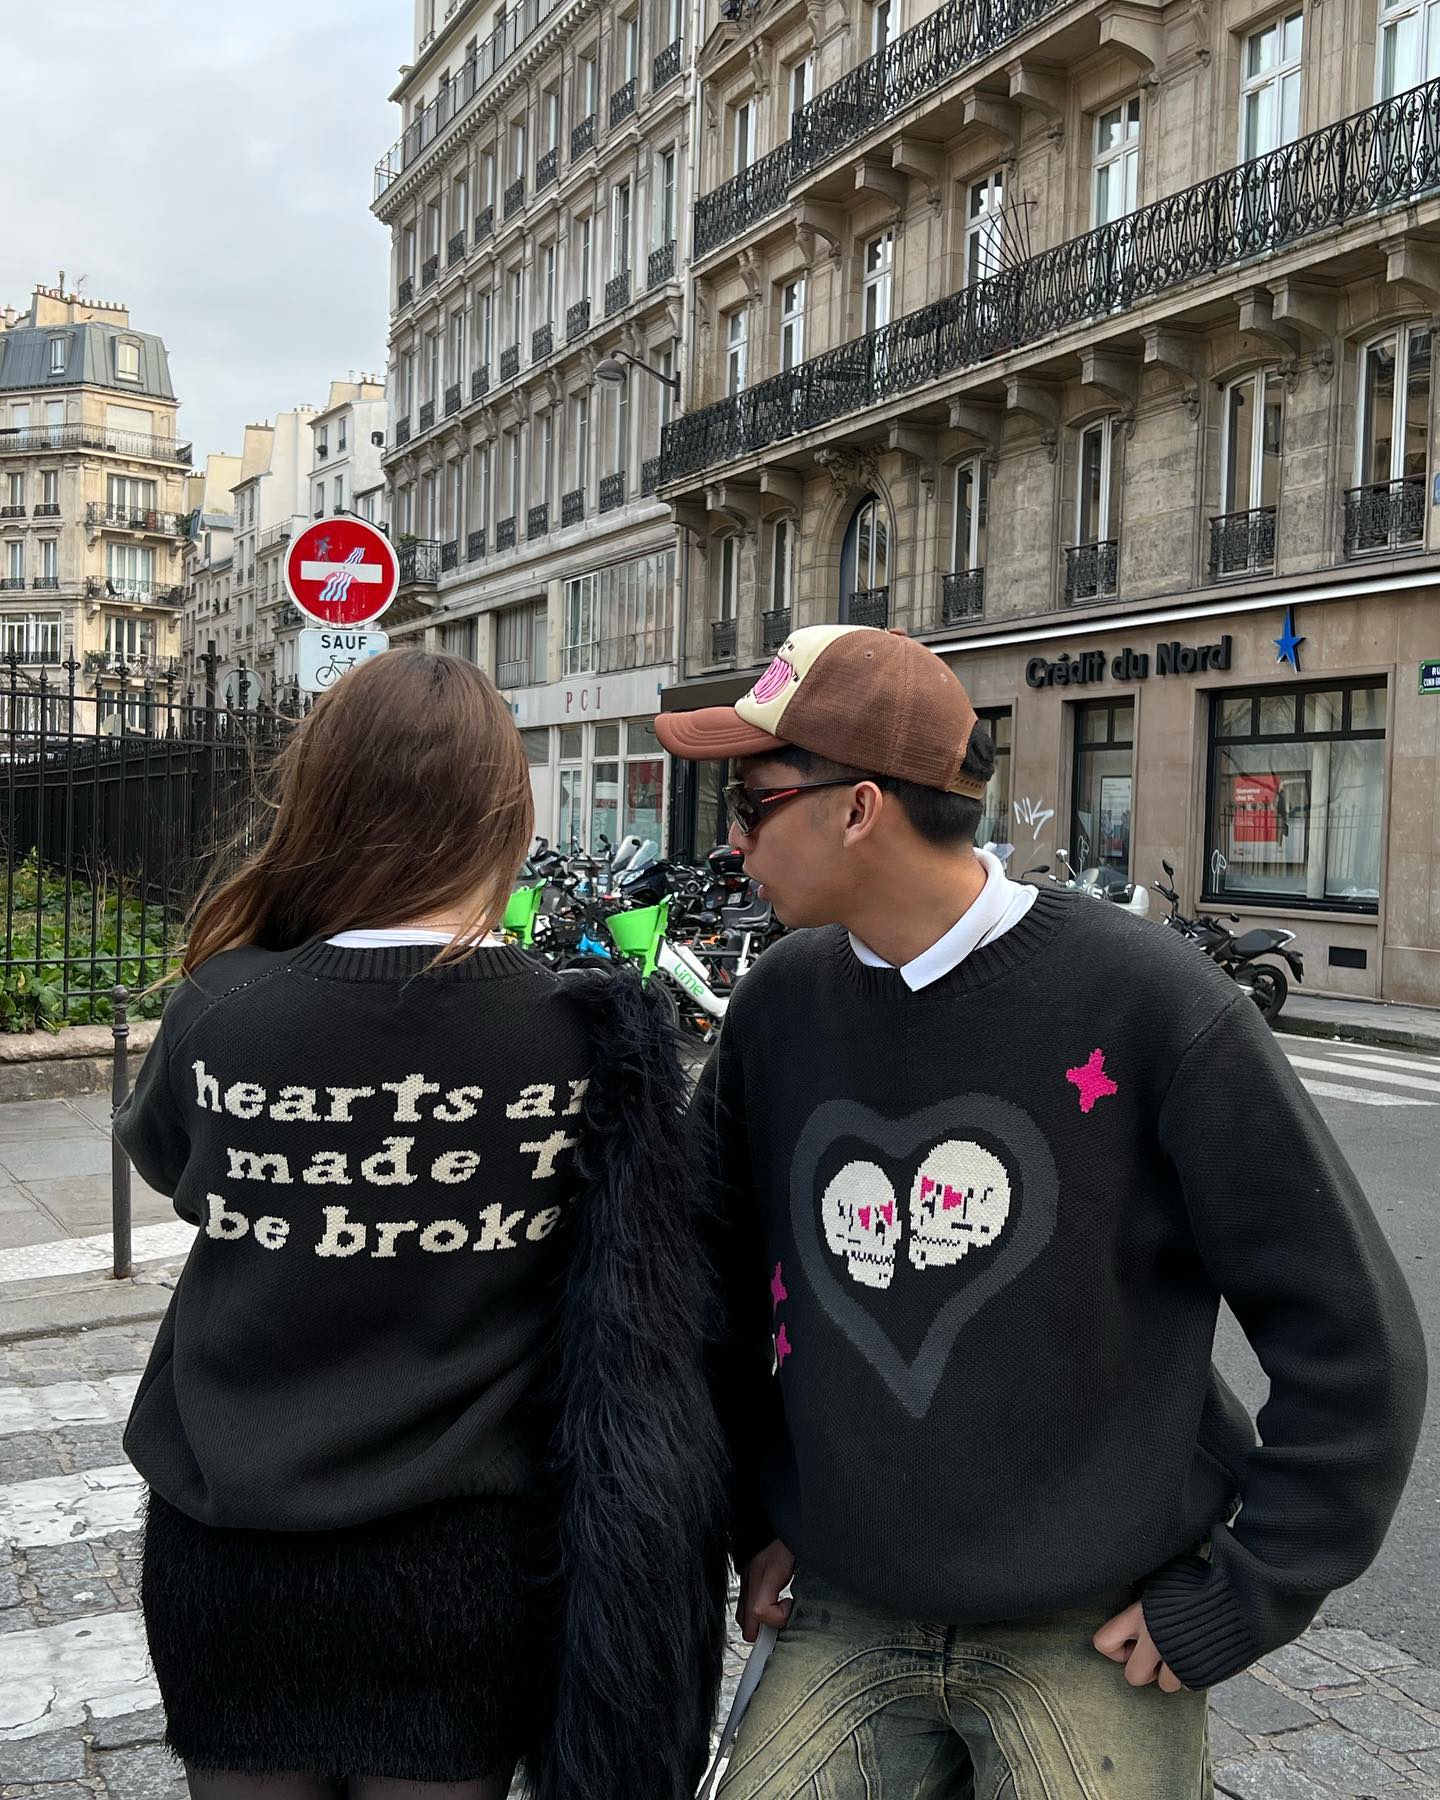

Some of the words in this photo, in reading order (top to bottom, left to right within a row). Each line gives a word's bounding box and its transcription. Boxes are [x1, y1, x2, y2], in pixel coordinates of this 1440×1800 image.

[321, 634, 367, 650] SAUF
[1025, 650, 1105, 688] Crédit
[1111, 648, 1149, 680] du
[1156, 635, 1232, 675] Nord
[191, 1060, 484, 1122] hearts
[226, 1136, 481, 1186] made
[205, 1192, 291, 1250] be
[314, 1202, 562, 1259] broke
